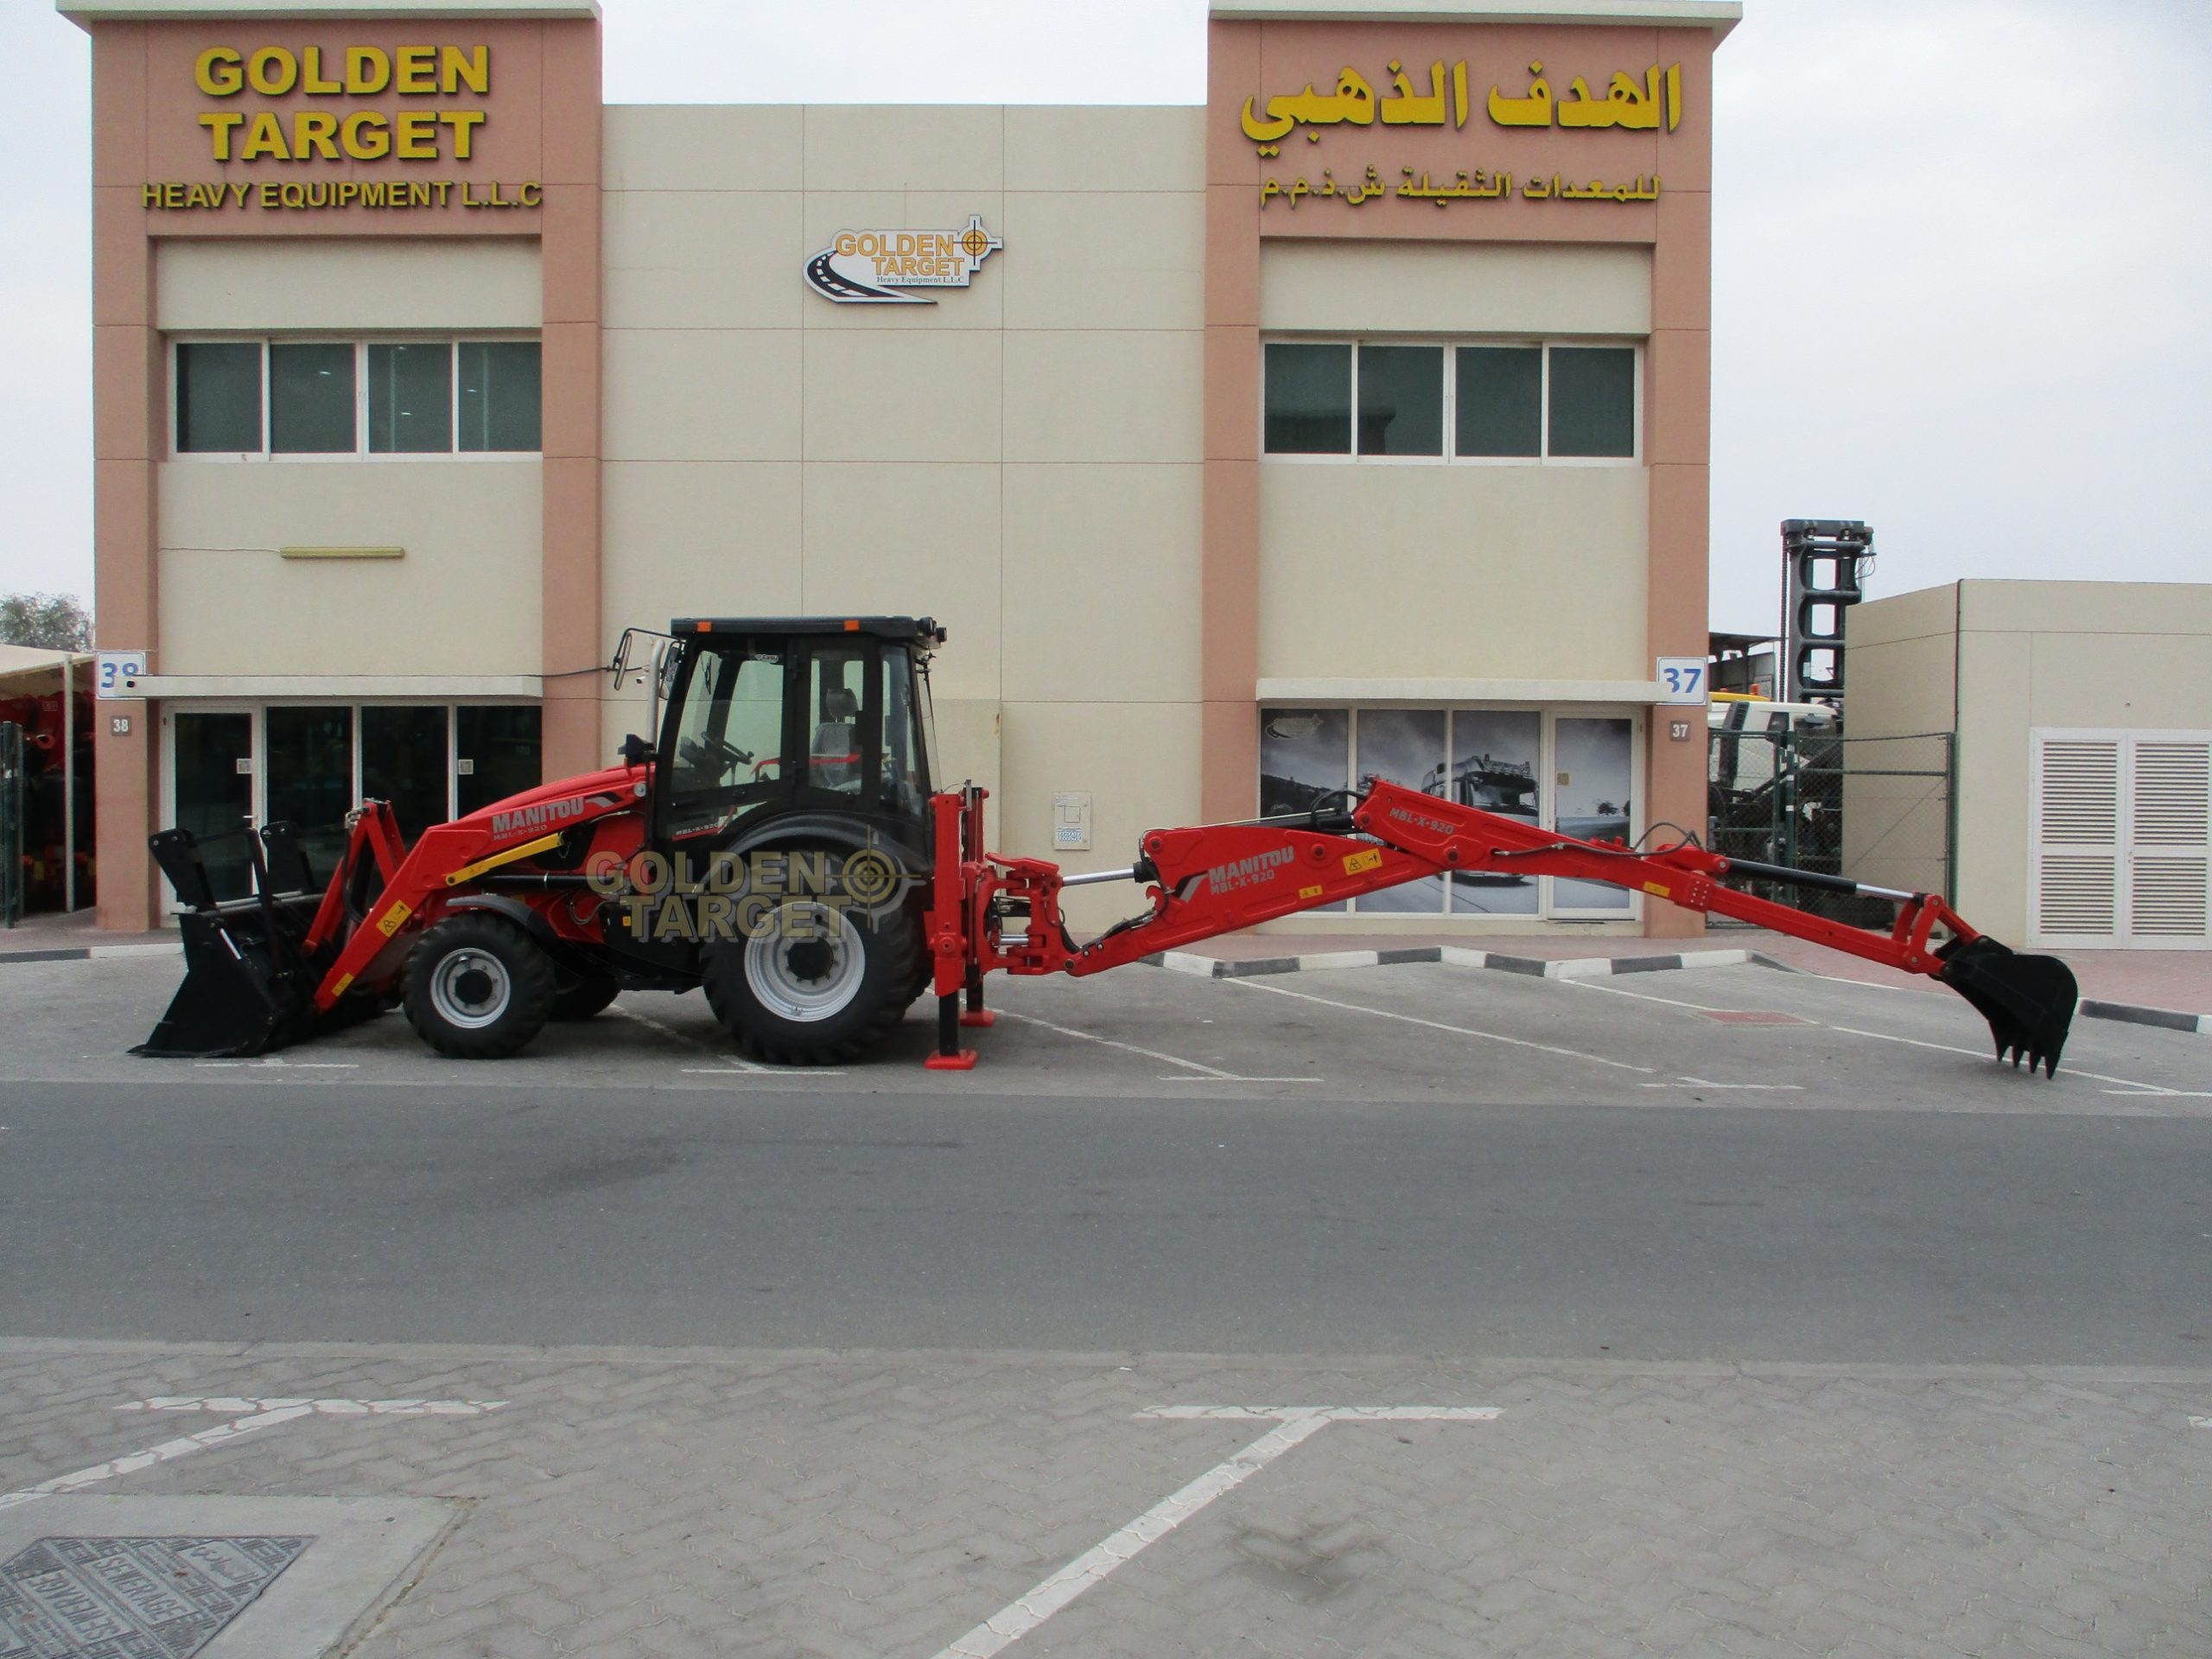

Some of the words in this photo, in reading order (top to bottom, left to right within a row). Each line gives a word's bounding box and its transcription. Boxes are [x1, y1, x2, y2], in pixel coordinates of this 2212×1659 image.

[194, 45, 490, 96] GOLDEN
[1240, 59, 1467, 157] الذهبي
[1487, 59, 1682, 134] الهدف
[199, 111, 486, 162] TARGET
[142, 181, 252, 209] HEAVY
[260, 180, 454, 210] EQUIPMENT
[462, 180, 543, 208] L.L.C
[1396, 166, 1512, 207] الثقيلة
[1522, 172, 1661, 204] للمعدات
[835, 233, 955, 257] GOLDEN
[871, 257, 965, 276] TARGET
[876, 276, 899, 285] Heavy
[901, 276, 942, 285] Equipment
[1663, 668, 1701, 693] 37
[113, 719, 129, 733] 38
[1672, 724, 1688, 738] 37
[493, 796, 585, 834] MANITOU
[1209, 844, 1294, 886] MANITOU
[27, 1572, 122, 1641] SEWERAGE
[91, 1556, 188, 1622] SEWERAGE
